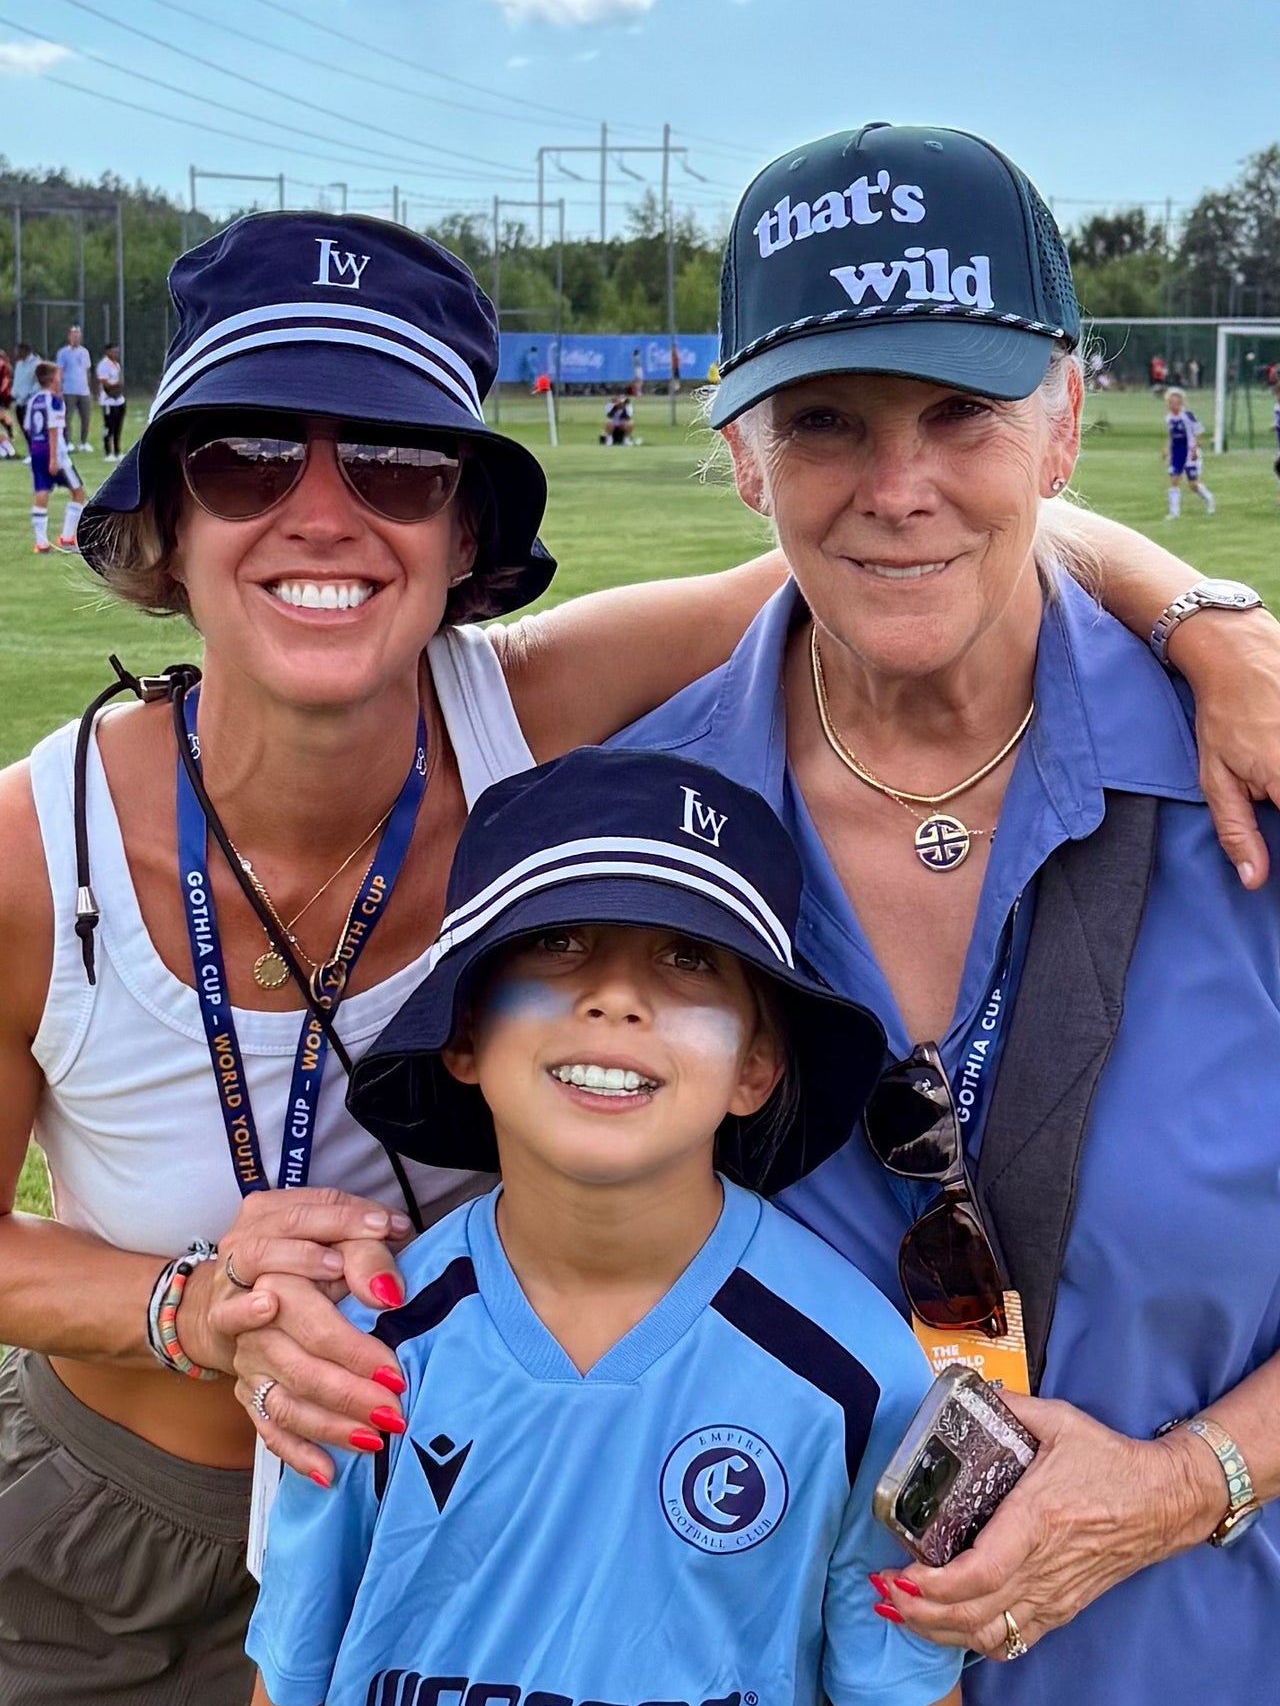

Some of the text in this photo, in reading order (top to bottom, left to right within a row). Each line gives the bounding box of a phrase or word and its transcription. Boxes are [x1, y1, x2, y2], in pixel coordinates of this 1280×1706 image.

[753, 169, 926, 259] that's
[829, 247, 995, 309] wild
[187, 871, 210, 957] GOTHIA
[202, 964, 221, 1006] CUP
[213, 1033, 241, 1107] WORLD
[232, 1118, 259, 1182] YOUTH
[292, 1097, 309, 1138] CUP
[301, 995, 332, 1071] WORD
[361, 874, 388, 914] CUP
[957, 1040, 990, 1124] GOTHIA
[981, 988, 1002, 1031] CUP
[931, 1344, 959, 1358] THE
[699, 1432, 764, 1458] EMPIRE
[667, 1498, 772, 1549] FOOTBALL CLUB
